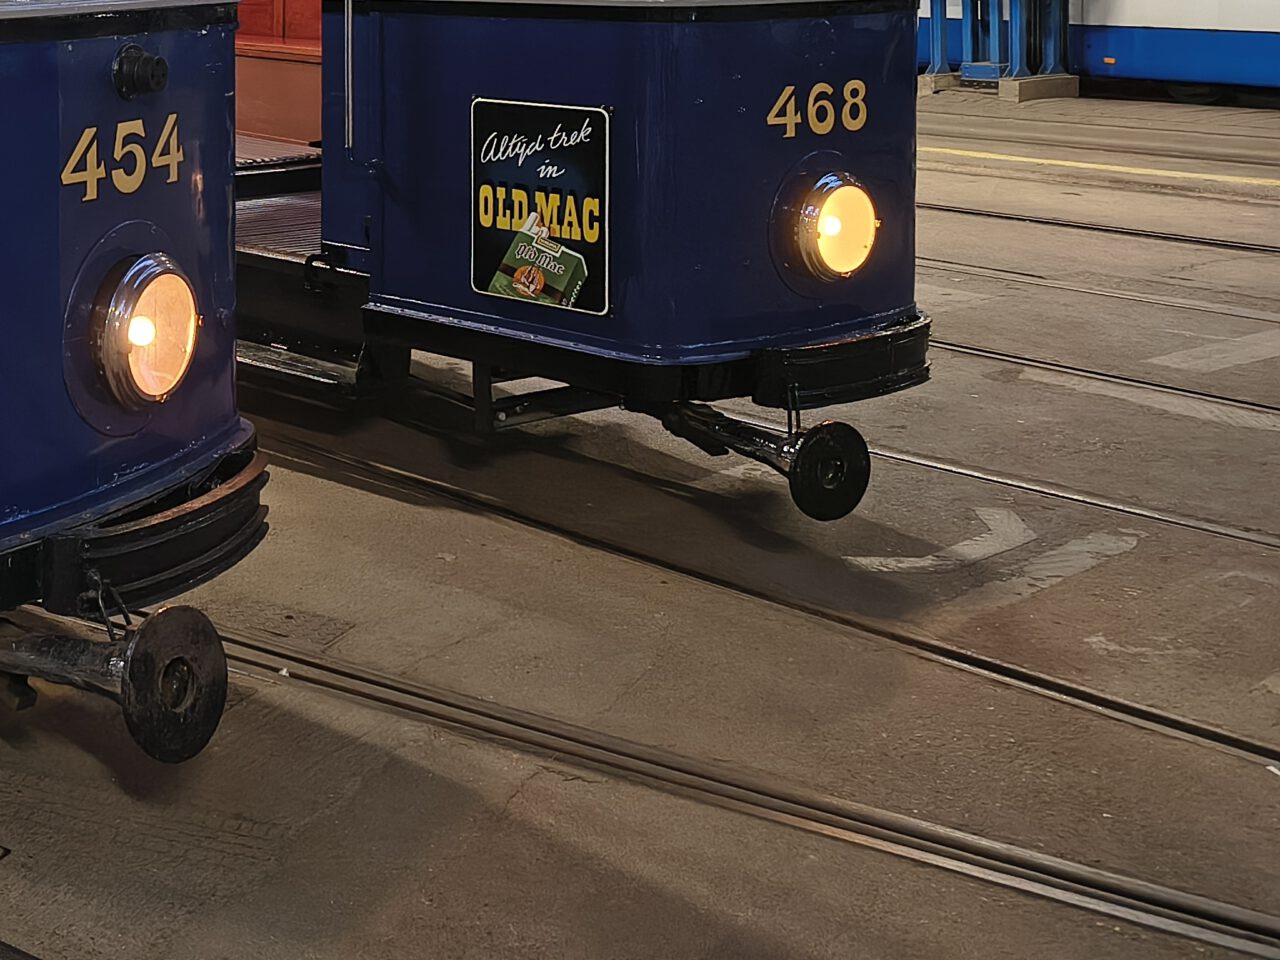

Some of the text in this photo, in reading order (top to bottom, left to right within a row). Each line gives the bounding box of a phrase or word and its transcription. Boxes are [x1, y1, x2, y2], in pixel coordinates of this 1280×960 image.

[766, 79, 868, 138] 468
[546, 117, 592, 150] trek
[60, 113, 185, 202] 454
[536, 159, 566, 179] in
[479, 184, 601, 244] OLD MAC
[536, 253, 566, 276] Mac
